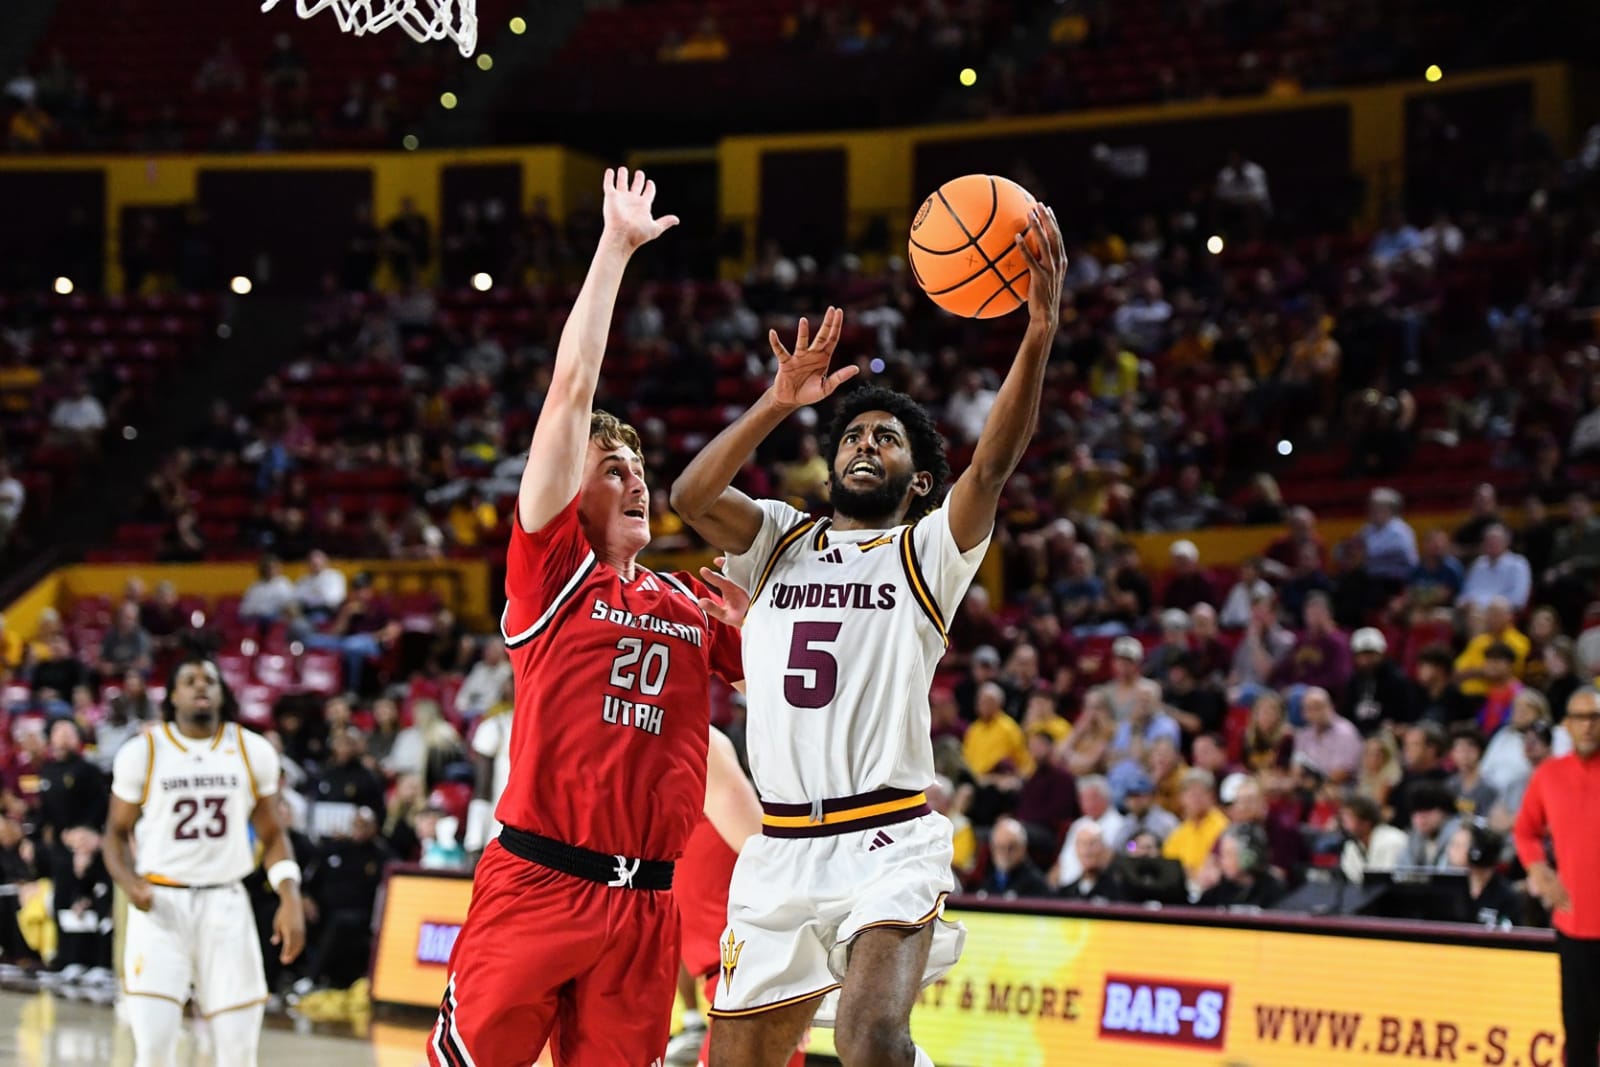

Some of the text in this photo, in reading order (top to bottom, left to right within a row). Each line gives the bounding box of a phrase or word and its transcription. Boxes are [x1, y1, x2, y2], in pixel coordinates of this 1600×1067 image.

[588, 599, 702, 647] SOUTHERN
[610, 636, 670, 696] 20
[783, 620, 843, 709] 5
[602, 695, 664, 736] UTAH
[172, 797, 228, 840] 23
[986, 982, 1082, 1021] MORE
[1102, 982, 1224, 1040] BAR-S
[1254, 1004, 1567, 1067] WWW.BAR-S.C
